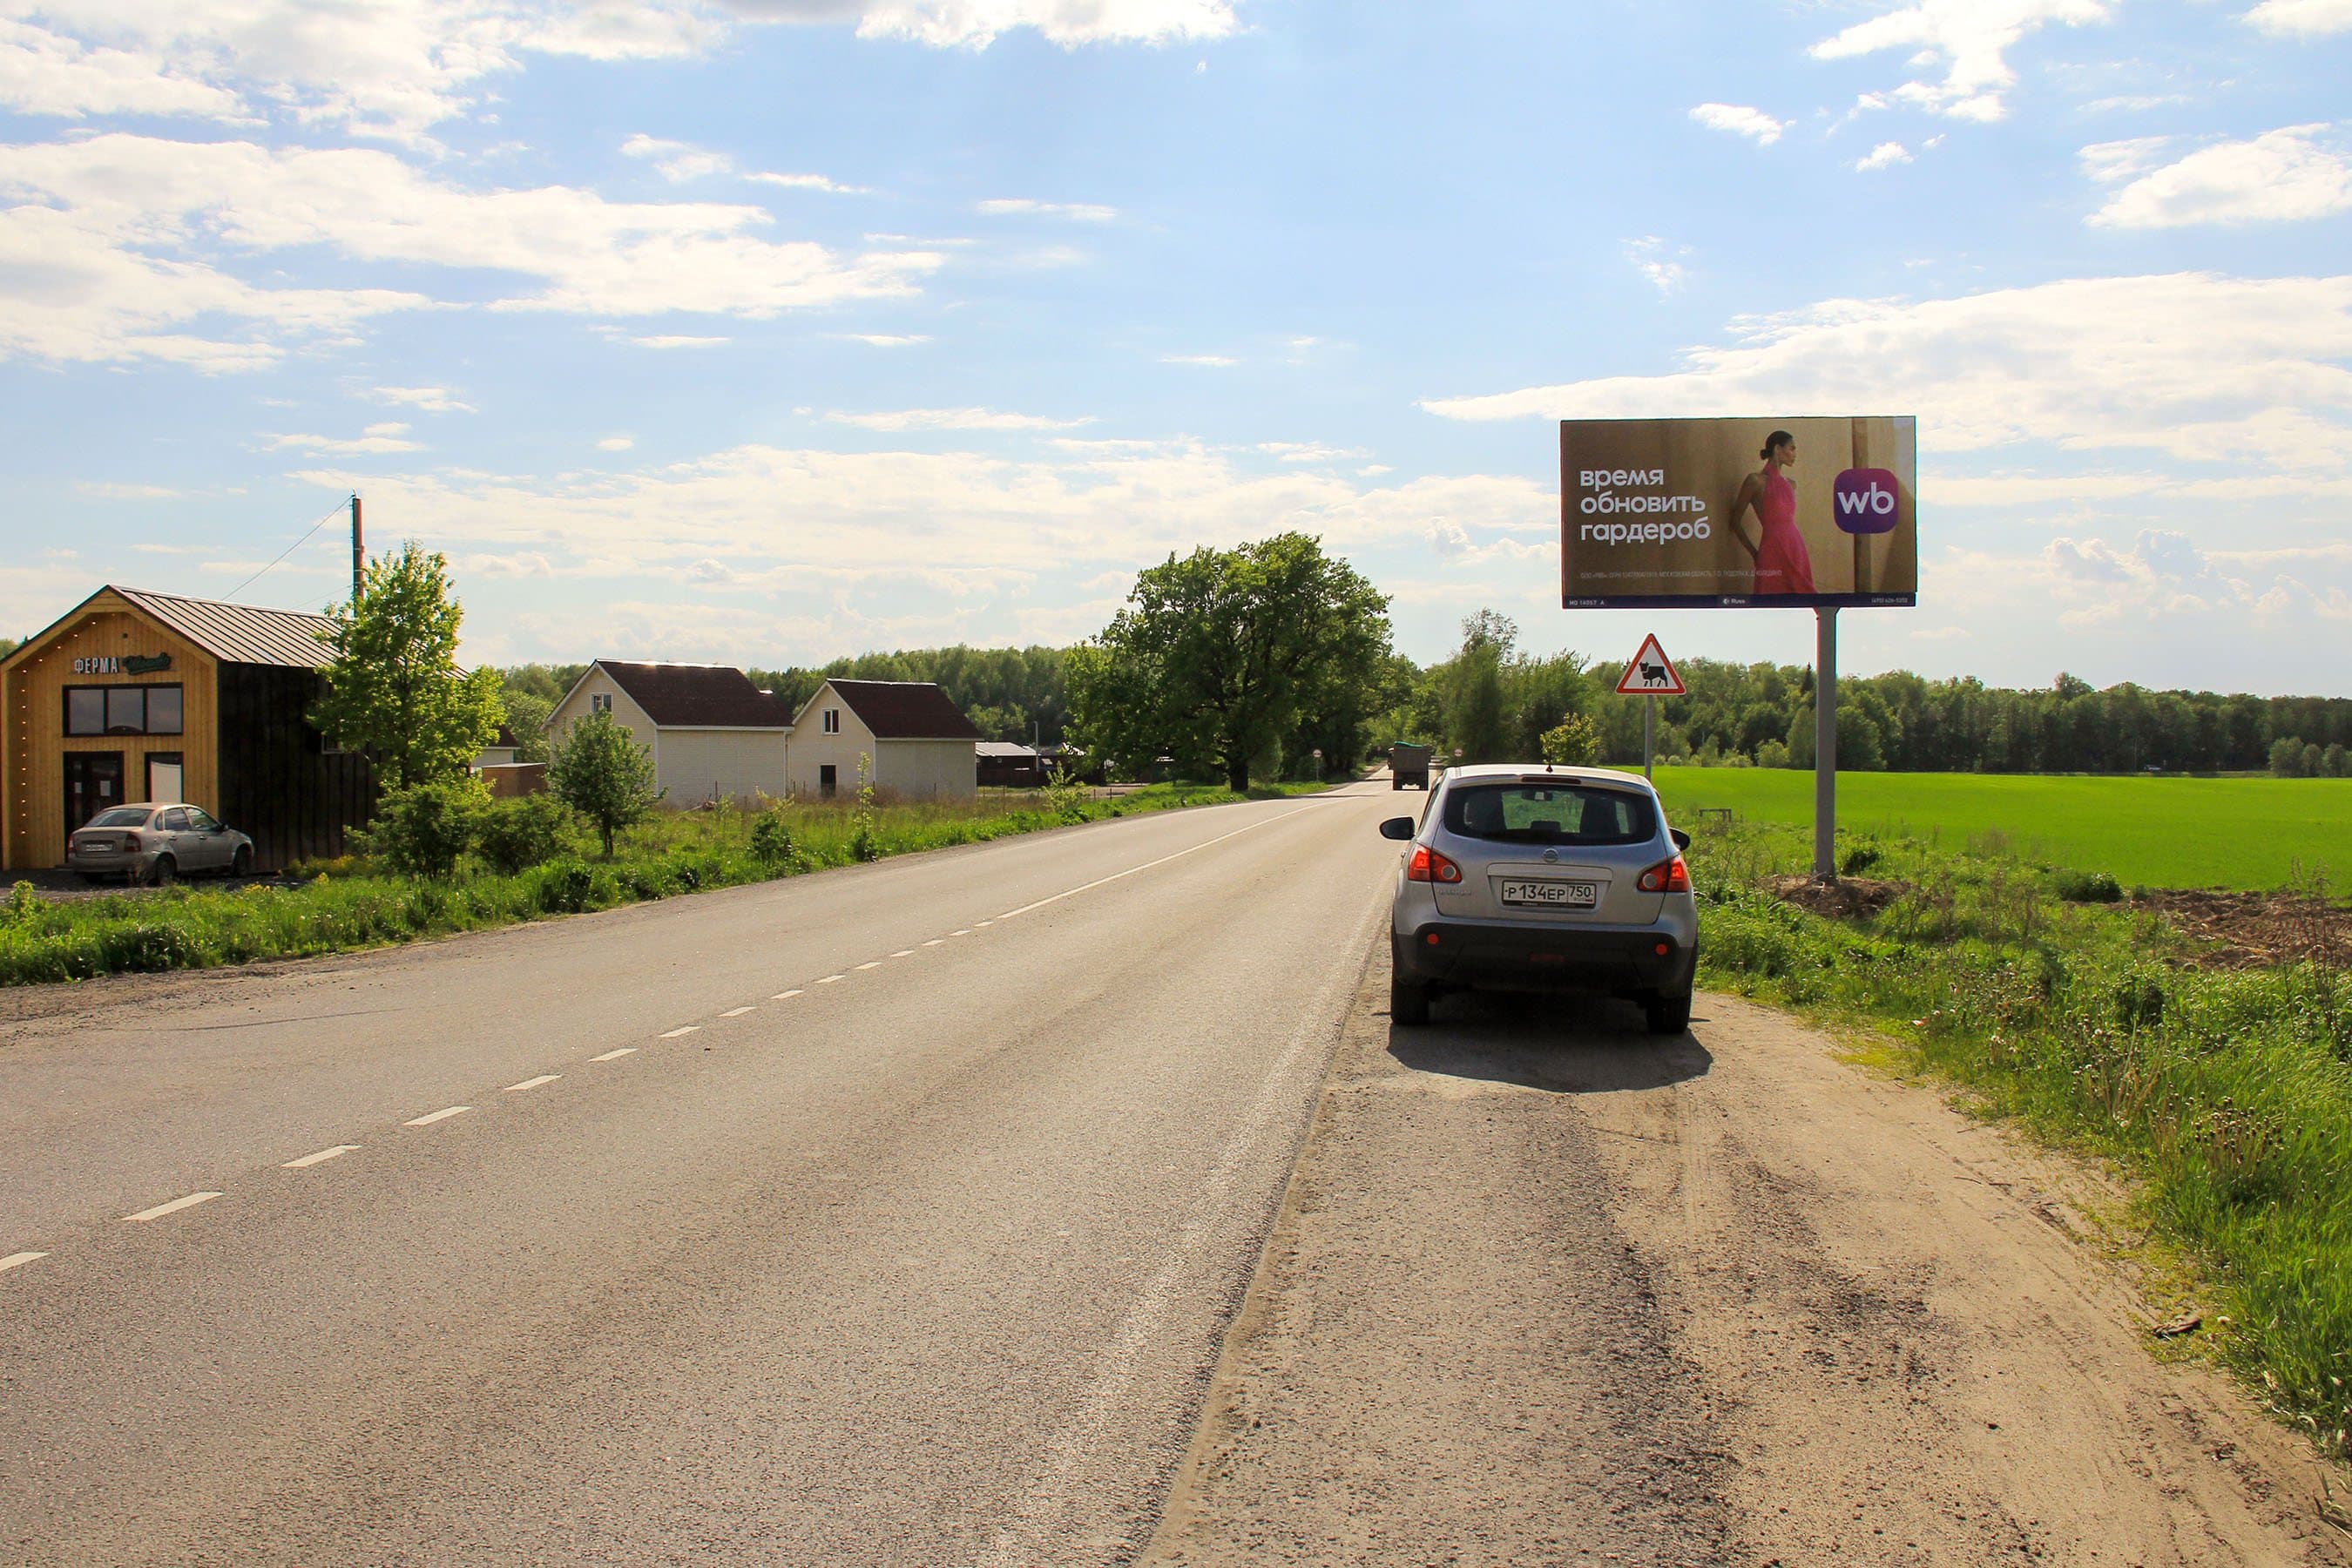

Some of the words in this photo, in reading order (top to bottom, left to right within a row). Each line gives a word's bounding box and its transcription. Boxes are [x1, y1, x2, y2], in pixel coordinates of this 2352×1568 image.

[1579, 468, 1664, 491] время
[1579, 490, 1706, 514] обновить
[1836, 481, 1895, 515] wb
[1579, 516, 1711, 546] гардероб
[74, 657, 118, 674] ФЕРМА
[1569, 885, 1592, 897] 750
